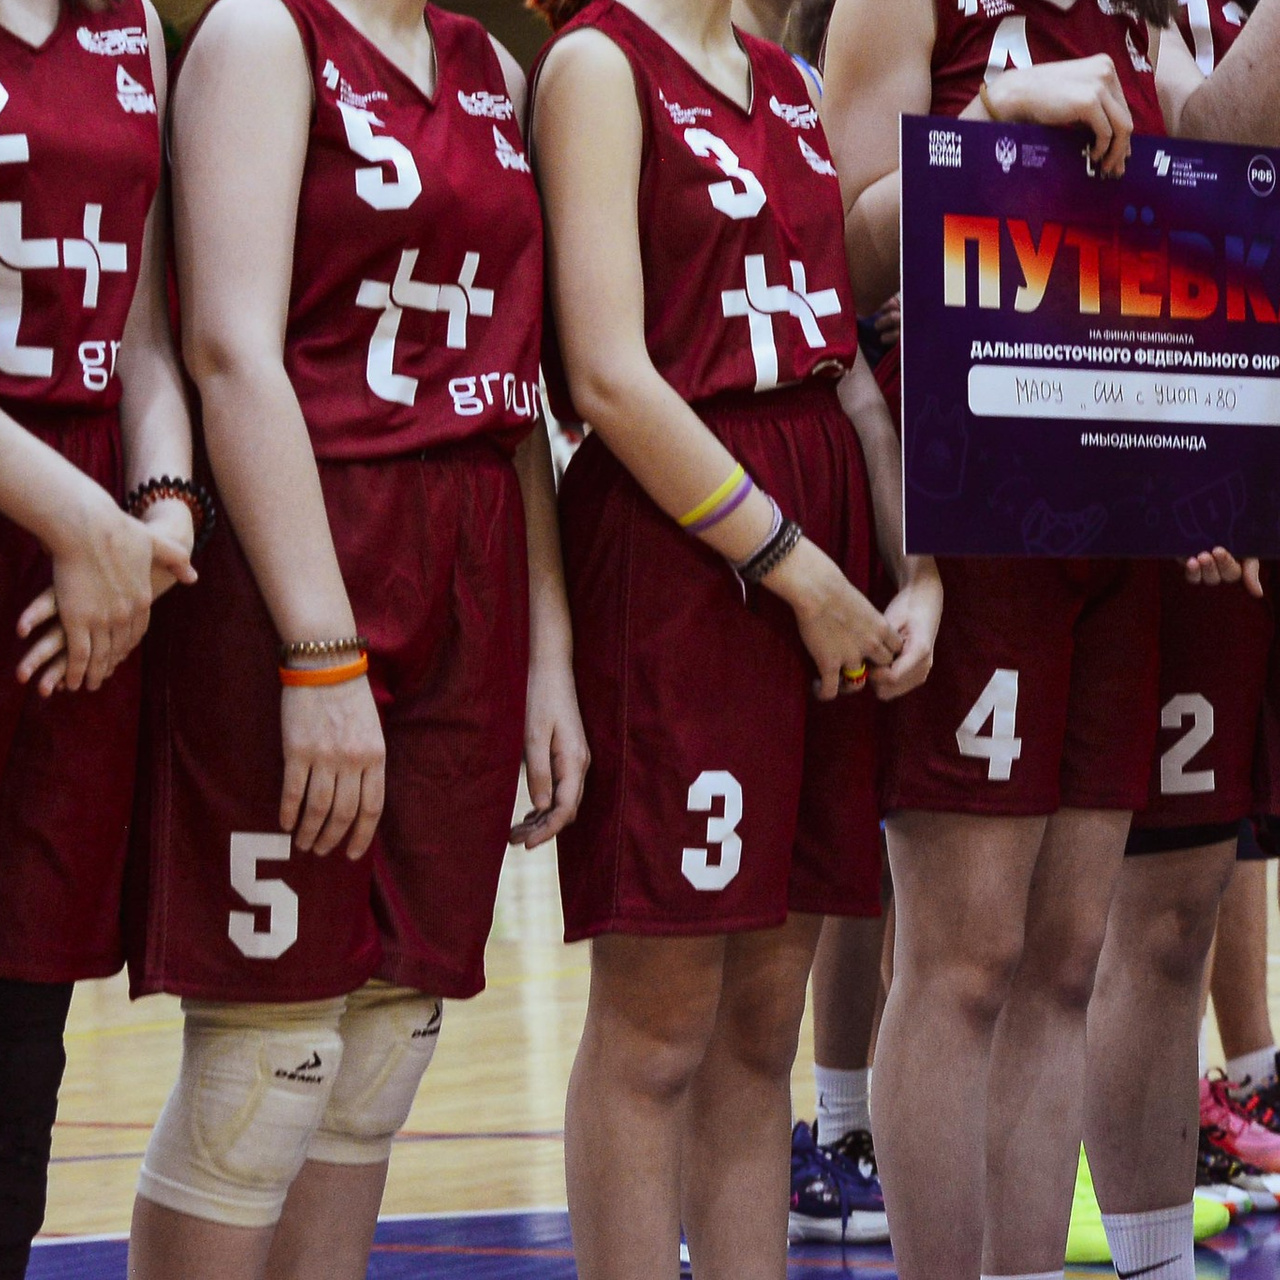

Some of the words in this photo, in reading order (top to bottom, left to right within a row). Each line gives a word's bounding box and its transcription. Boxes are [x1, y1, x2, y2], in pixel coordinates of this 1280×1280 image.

[336, 100, 422, 210] 5
[684, 128, 767, 219] 3
[970, 340, 1131, 365] ДАЛЬНЕВОСТОЧНОГО
[1134, 348, 1249, 369] ФЕДЕРАЛЬНОГО
[1089, 329, 1102, 340] НА
[1103, 329, 1136, 342] ФИНАЛ
[1137, 331, 1195, 345] ЧЕМПИОНАТА
[1015, 376, 1063, 406] МАОУ
[1081, 432, 1207, 452] #МЫОДНАКОМАНДА
[955, 668, 1022, 781] 4
[1159, 693, 1215, 795] 2
[680, 770, 743, 892] 3
[227, 832, 299, 960] 5
